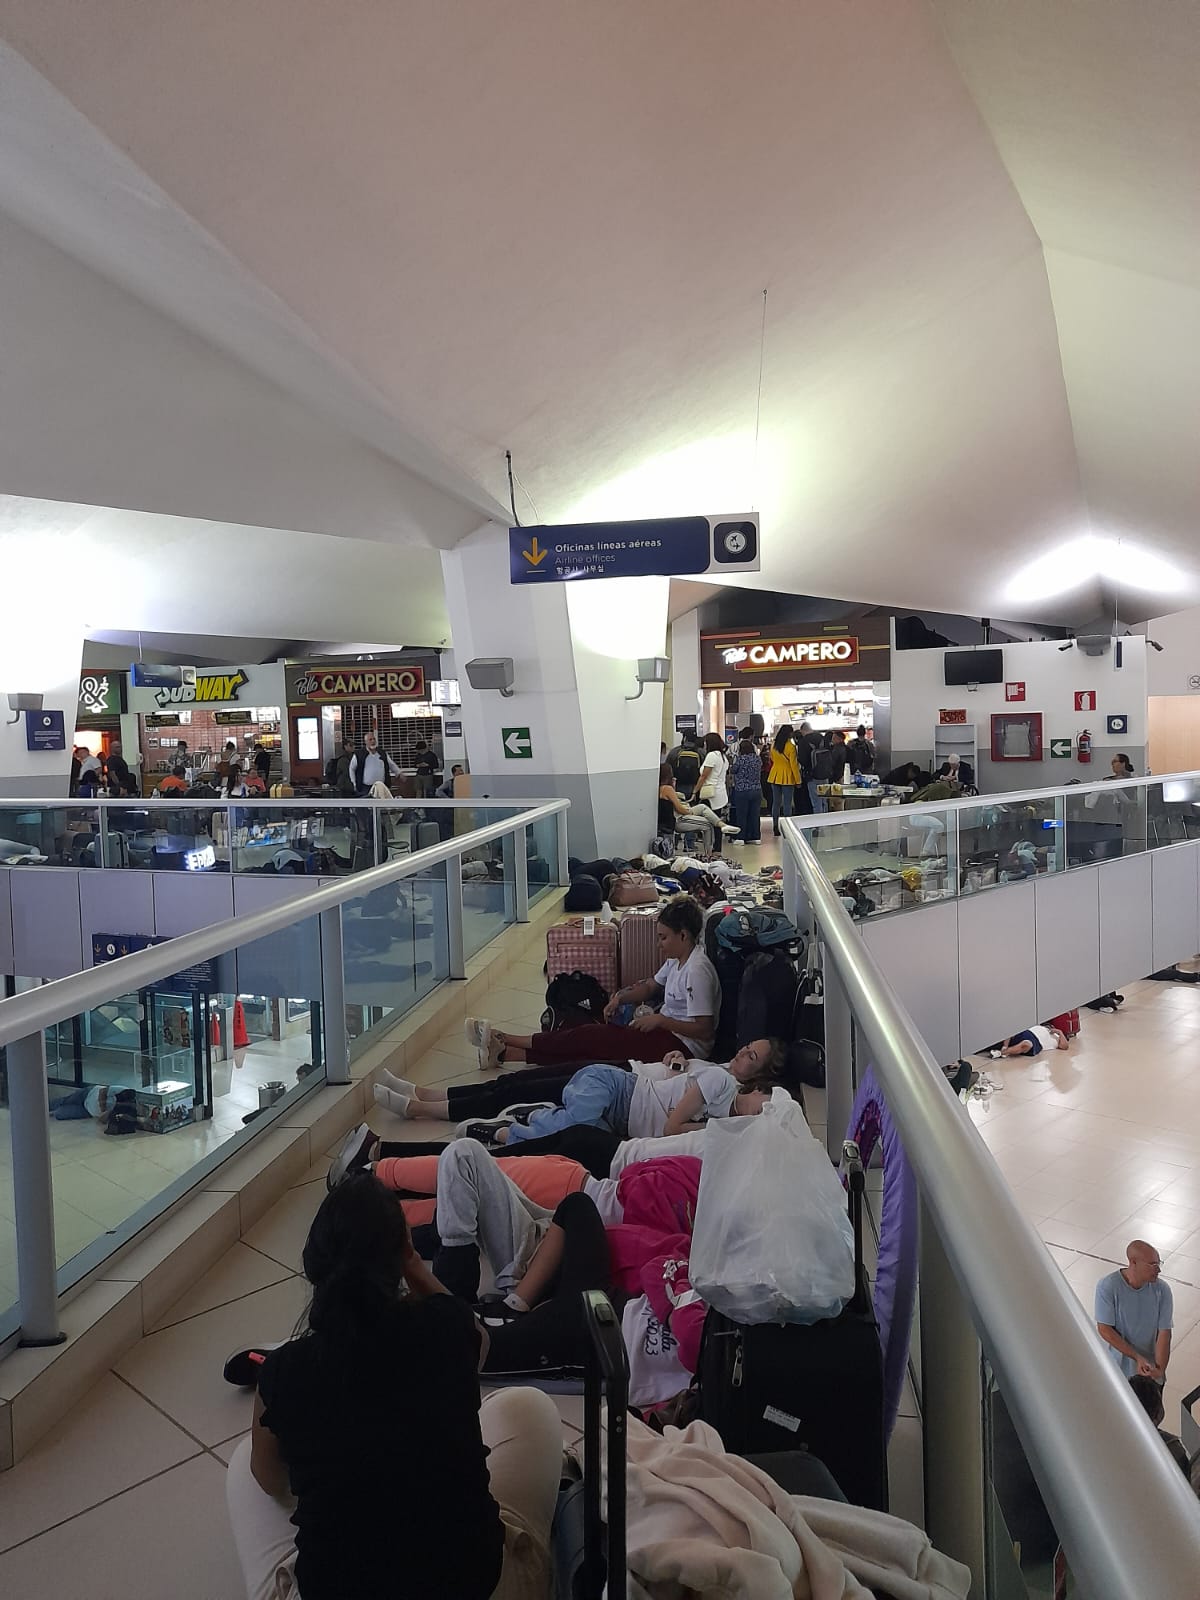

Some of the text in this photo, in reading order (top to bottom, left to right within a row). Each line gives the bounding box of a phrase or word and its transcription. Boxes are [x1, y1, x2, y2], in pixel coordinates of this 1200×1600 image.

[555, 539, 662, 553] Oficinas líneas aéreas
[555, 553, 616, 564] Airline offices
[749, 641, 852, 664] CAMPERO
[156, 672, 244, 703] SUBWAY
[321, 672, 416, 694] CAMPERO
[645, 1317, 659, 1356] 2023
